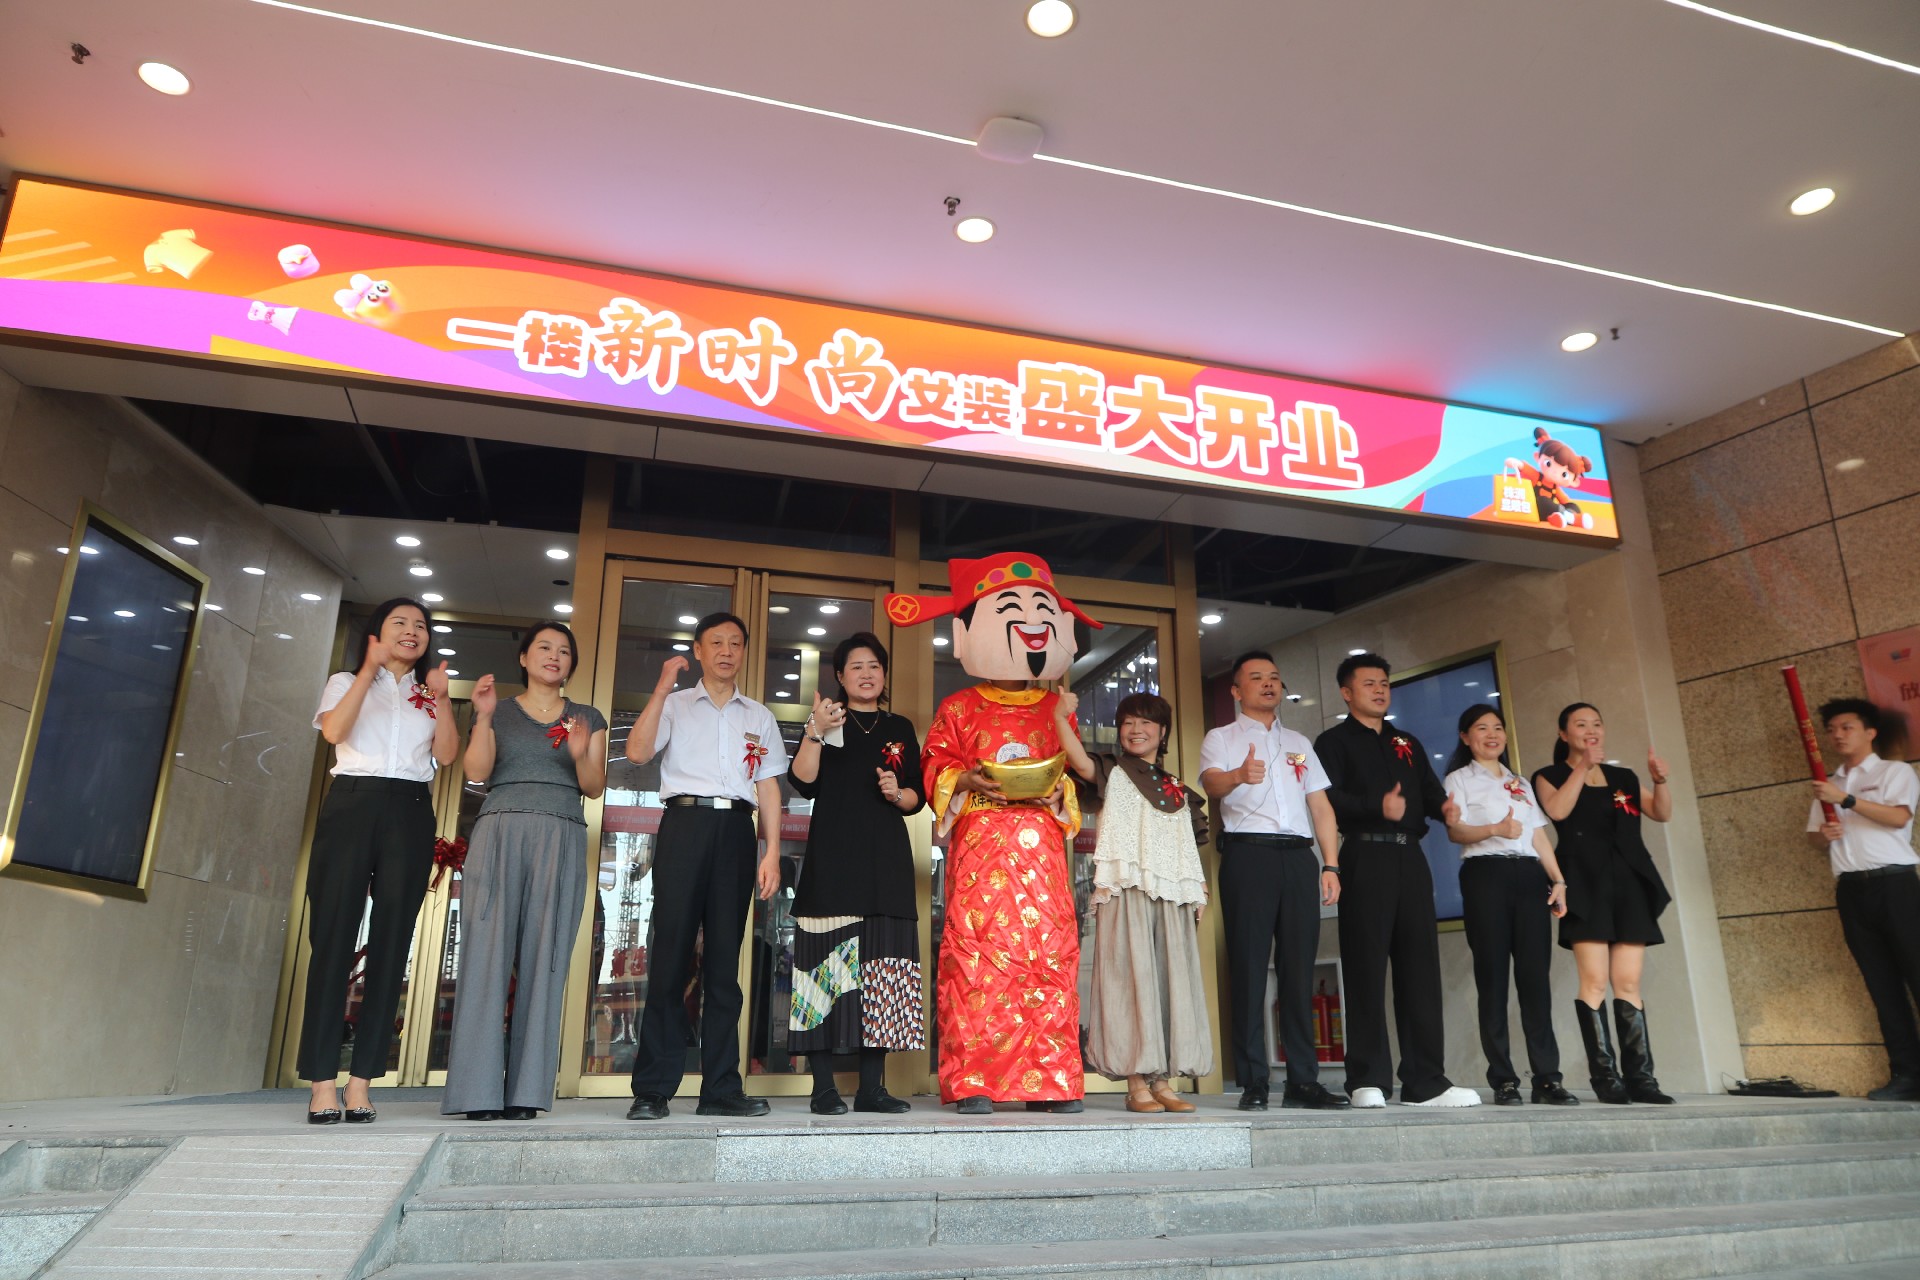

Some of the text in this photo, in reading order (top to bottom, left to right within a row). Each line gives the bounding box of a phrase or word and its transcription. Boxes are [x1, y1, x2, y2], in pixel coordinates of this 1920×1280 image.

[446, 297, 1365, 489] 一楼新时尚女装盛大开业
